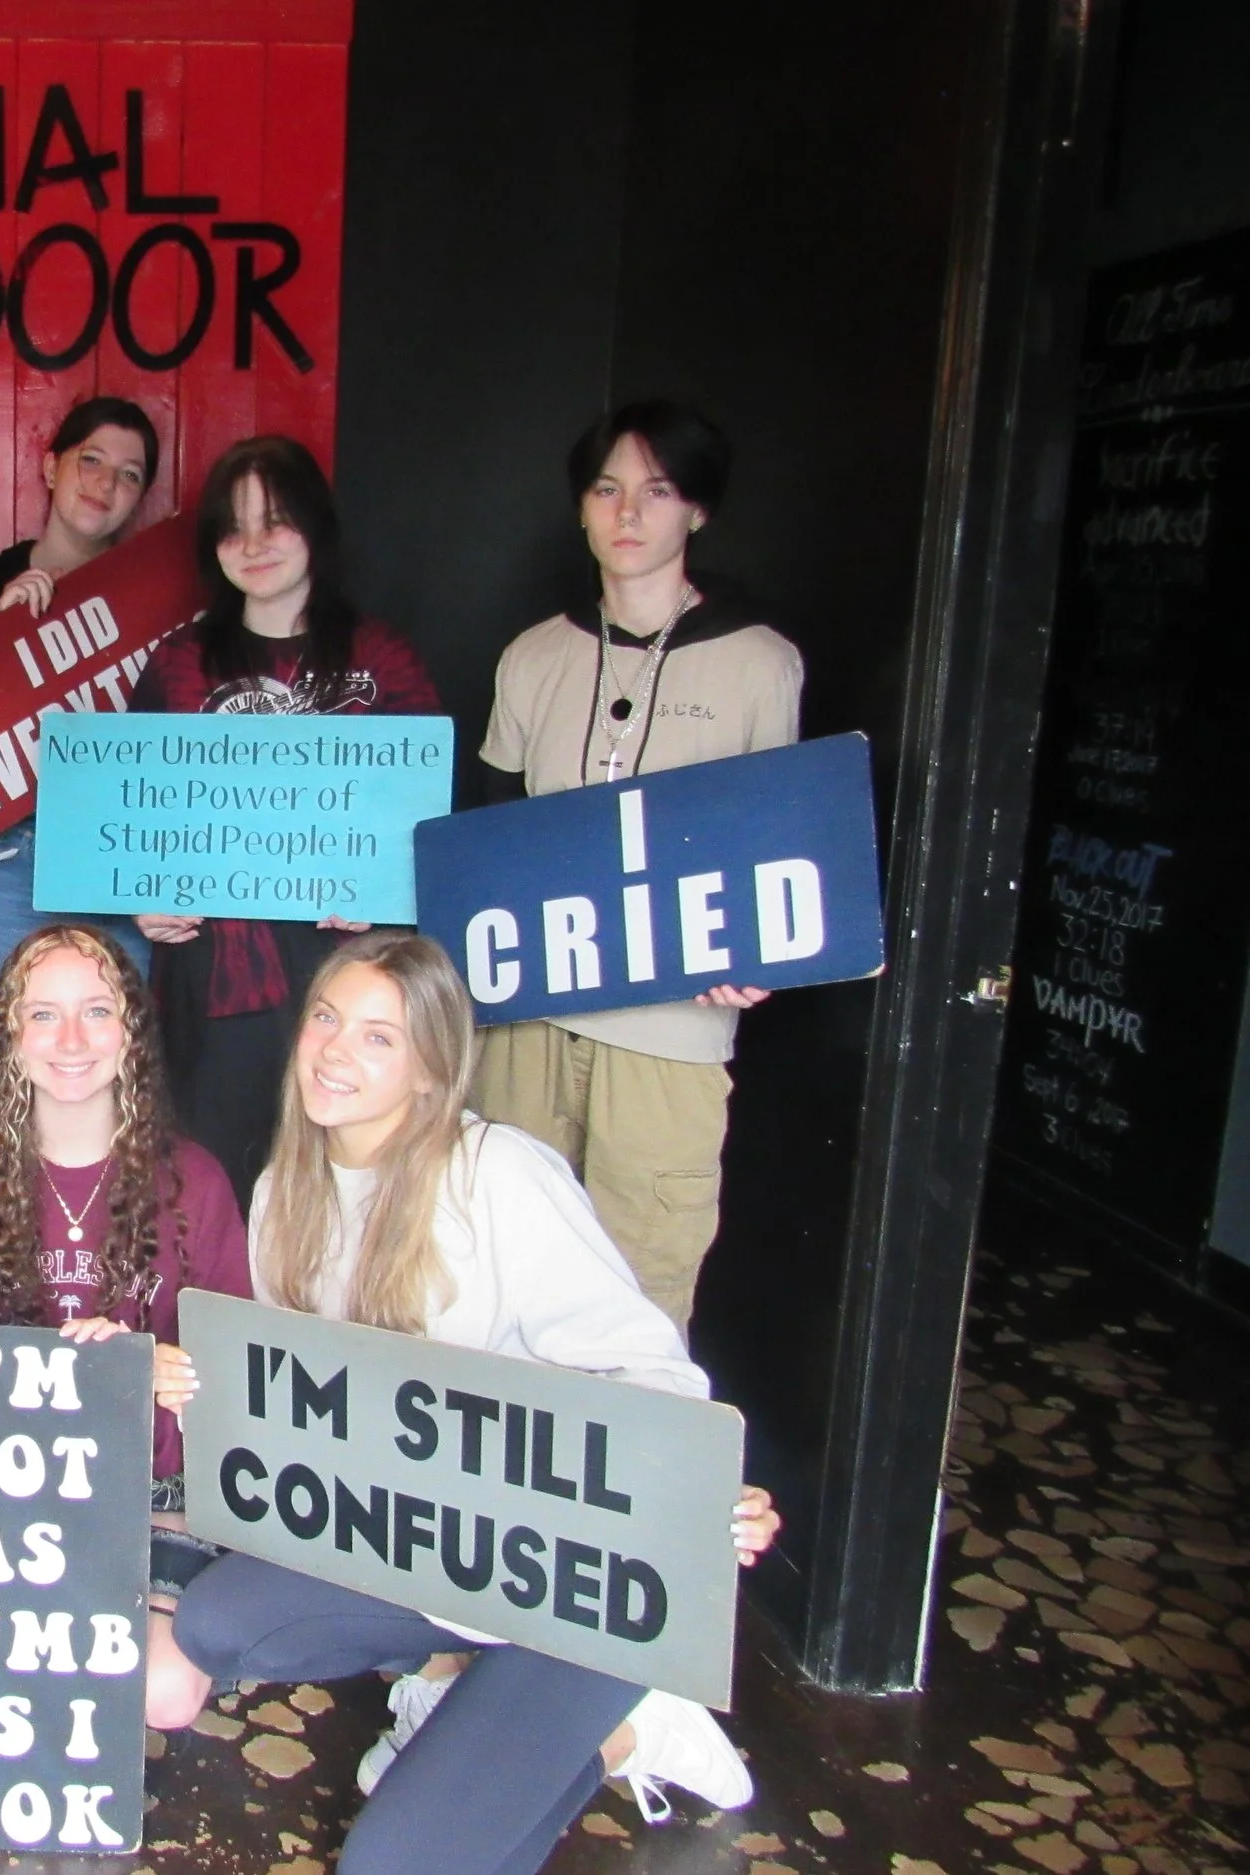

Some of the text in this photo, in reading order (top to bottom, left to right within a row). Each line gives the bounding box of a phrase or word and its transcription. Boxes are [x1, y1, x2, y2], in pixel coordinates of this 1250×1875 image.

[13, 596, 120, 689] I DID
[656, 703, 716, 720] ふじさん
[48, 732, 441, 768] Never Underestimate
[120, 778, 359, 812] the Power of
[98, 821, 378, 864] Stupid People in
[618, 788, 647, 874] I
[112, 867, 359, 910] Large Groups
[465, 858, 826, 1004] CRIED
[1056, 913, 1126, 968] 32:18
[246, 1342, 632, 1515] I'M STILL
[219, 1446, 669, 1645] CONFUSED
[64, 1698, 100, 1761] I
